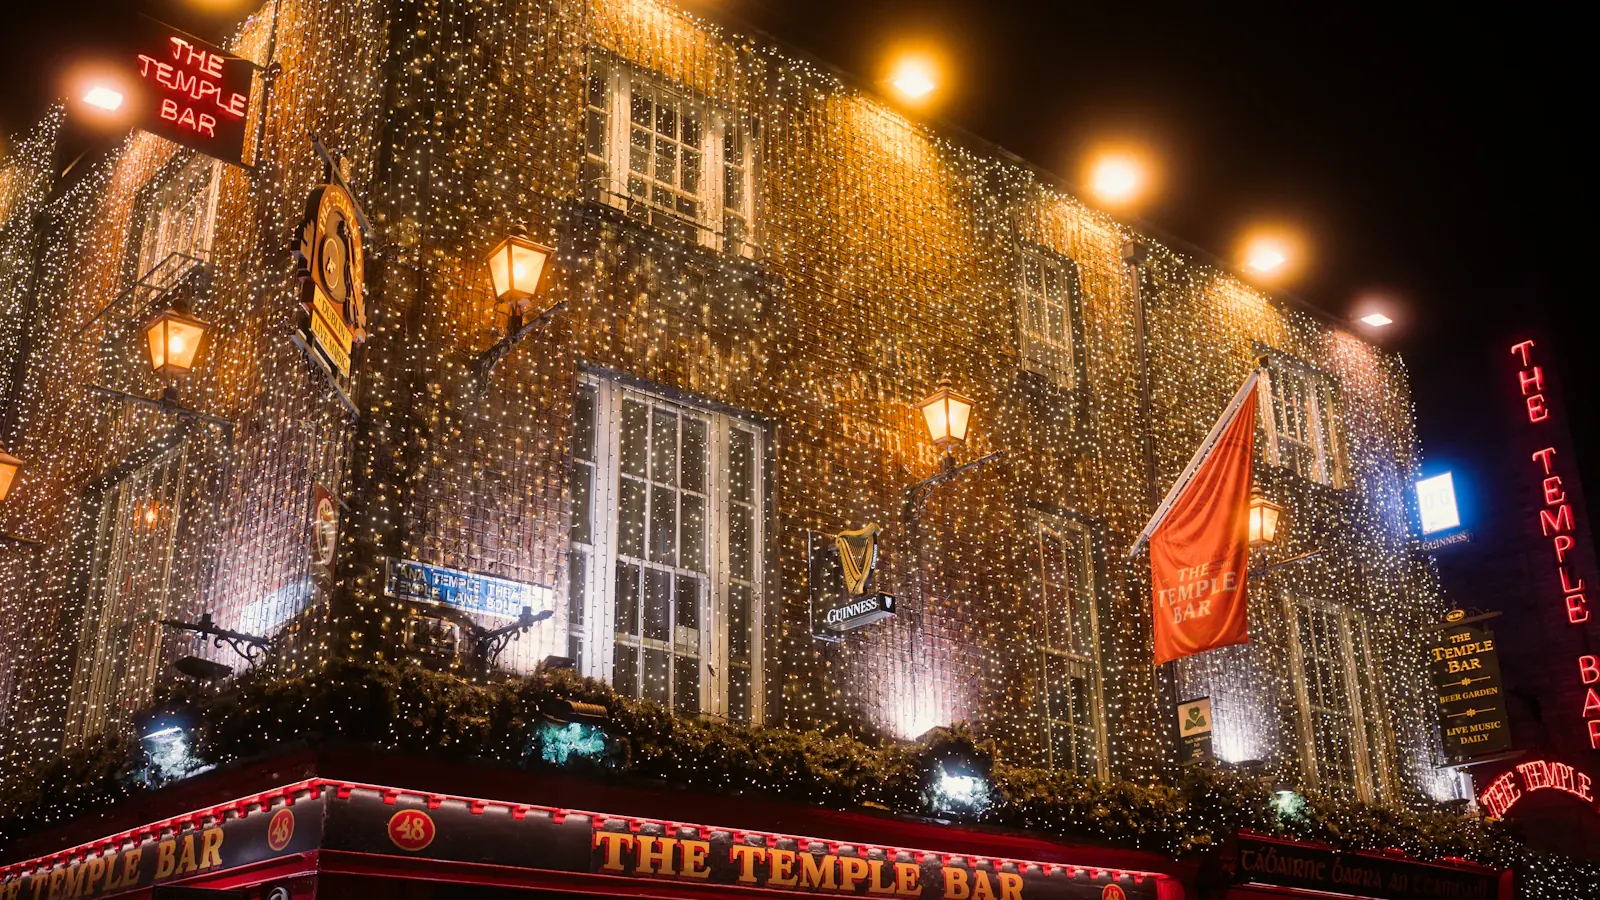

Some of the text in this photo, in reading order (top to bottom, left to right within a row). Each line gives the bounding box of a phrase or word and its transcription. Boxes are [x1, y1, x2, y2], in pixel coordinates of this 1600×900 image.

[170, 36, 224, 79] THE
[138, 54, 247, 117] TEMPLE
[161, 98, 217, 138] BAR
[322, 300, 345, 340] DUBLIN
[314, 318, 348, 370] LIVE MUSIC
[1511, 340, 1549, 422] THE
[1532, 447, 1589, 623] TEMPLE
[1422, 531, 1468, 551] GUINNESS
[432, 572, 480, 593] TEMPLE
[1178, 562, 1209, 582] THE
[446, 589, 480, 606] LANE
[1158, 571, 1237, 608] TEMPLE
[827, 597, 877, 623] GUINNESS
[1173, 600, 1212, 625] BAR
[1450, 632, 1471, 644] THE
[1431, 640, 1494, 662] TEMPLE
[1447, 658, 1482, 674] BAR
[1440, 687, 1498, 704] BEER GARDEN
[1446, 720, 1501, 736] LIVE MUSIC
[1460, 733, 1490, 745] DAILY
[1481, 760, 1593, 818] THE TEMPLE
[272, 816, 289, 843] 48
[395, 815, 425, 840] 48
[31, 827, 224, 900] TEMPLE BAR
[595, 831, 1025, 900] THE TEMPLE BAR
